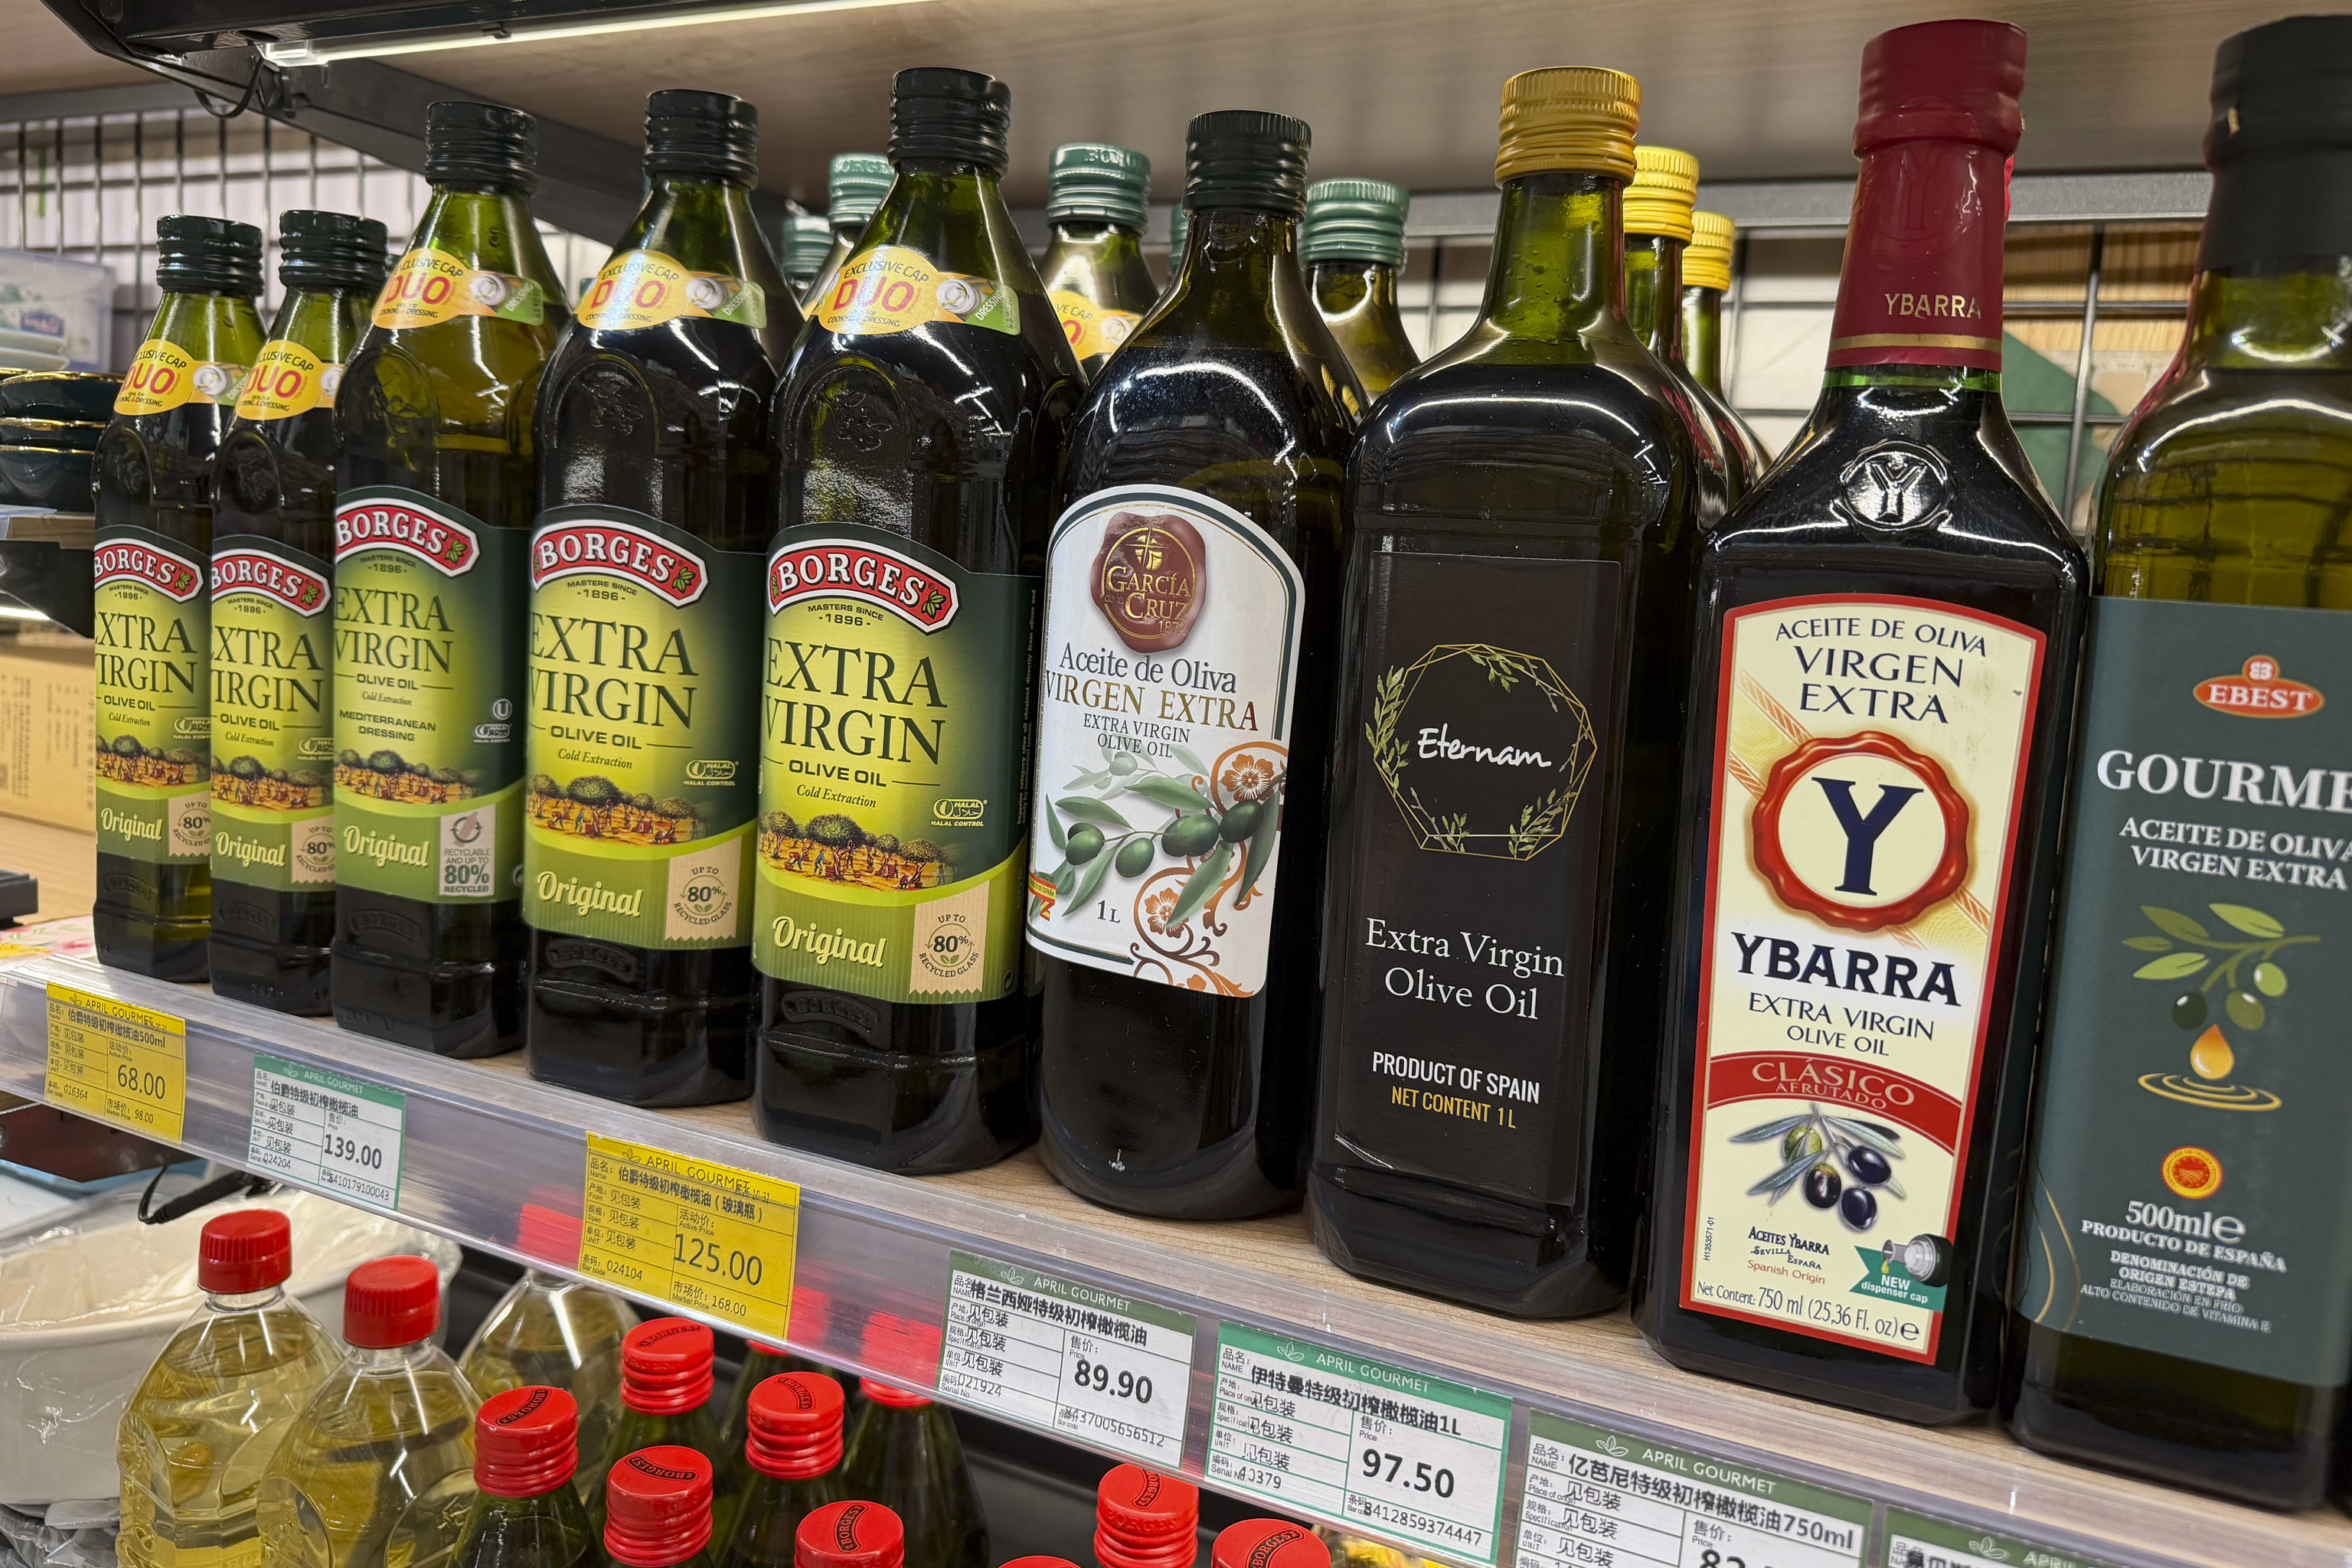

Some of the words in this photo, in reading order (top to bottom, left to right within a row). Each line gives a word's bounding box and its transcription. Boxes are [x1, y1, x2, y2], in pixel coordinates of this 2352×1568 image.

[903, 266, 929, 283] CAP
[833, 276, 915, 312] DUO
[974, 289, 1005, 322] DRESSING
[1884, 293, 1981, 319] YBARRA
[337, 511, 448, 554] BORGES
[94, 548, 177, 584] BORGES
[539, 533, 675, 583] BORGES
[211, 560, 304, 598] BORGES
[777, 553, 926, 608] BORGES
[335, 586, 454, 632] EXTRA
[807, 603, 854, 612] MASTERS
[856, 606, 884, 622] SINCE
[1158, 620, 1187, 635] 1872
[335, 628, 454, 674] VIRGIN
[531, 612, 699, 676] EXTRA
[1775, 617, 1861, 642] ACEITE
[1870, 618, 1905, 640] DE
[1915, 624, 1987, 658] OLIVA
[767, 636, 948, 708] EXTRA
[1059, 642, 1129, 678] Aceite
[1135, 655, 1164, 684] de
[1171, 658, 1238, 694] Oliva
[1794, 645, 1964, 688] VIRGEN
[530, 665, 697, 729] VIRGIN
[1046, 669, 1145, 715] VIRGEN
[1158, 689, 1259, 732] EXTRA
[1799, 682, 1949, 724] EXTRA
[2206, 684, 2314, 712] EBEST
[339, 710, 436, 731] MEDITERRANEAN
[358, 726, 415, 741] DRESSING
[765, 694, 946, 766] VIRGIN
[1083, 713, 1129, 734] EXTRA
[1132, 720, 1191, 743] VIRGIN
[1097, 733, 1142, 754] OLIVE
[1148, 740, 1174, 759] OIL
[1417, 723, 1552, 768] Eternam
[789, 759, 849, 781] OLIVE
[854, 769, 887, 787] OIL
[796, 784, 820, 799] Cold
[822, 789, 877, 808] Extraction
[101, 807, 163, 841] Original
[1811, 776, 1925, 897] Y
[2118, 816, 2222, 848] ACEITE
[2226, 828, 2266, 853] DE
[216, 831, 287, 868] Original
[345, 825, 430, 867] Original
[444, 848, 491, 856] RECYCLABLE
[444, 864, 490, 885] 80%
[2131, 844, 2242, 879] VIRGEN
[2245, 858, 2349, 891] EXTRA
[537, 871, 643, 916] Original
[938, 914, 951, 923] UP
[953, 913, 966, 923] TO
[773, 915, 887, 968] Original
[933, 935, 969, 952] 80%
[1365, 917, 1451, 958] Extra
[1460, 931, 1565, 979] Virgin
[920, 952, 956, 978] RECYCLED
[957, 952, 978, 975] GLASS
[1730, 932, 1962, 1008] YBARRA
[86, 998, 108, 1014] APRIL
[113, 1006, 153, 1025] GOURMET
[1385, 966, 1473, 1008] Olive
[1485, 983, 1538, 1020] Oil
[1749, 991, 1832, 1024] EXTRA
[1843, 1007, 1935, 1041] VIRGIN
[1786, 1025, 1847, 1049] OLIVE
[1854, 1036, 1890, 1057] OIL
[64, 1084, 88, 1101] 016364
[117, 1064, 165, 1100] 68.00
[304, 1071, 325, 1084] APRIL
[327, 1076, 363, 1094] GOURMET
[1372, 1051, 1456, 1086] PRODUCT
[1459, 1067, 1483, 1091] OF
[1486, 1073, 1540, 1105] SPAIN
[1752, 1058, 1916, 1107] CLÁSICO
[1775, 1082, 1887, 1110] AFRUTADO
[135, 1109, 154, 1124] 98.00
[1391, 1086, 1419, 1108] NET
[1422, 1092, 1491, 1122] CONTENT
[263, 1152, 291, 1170] 024204
[324, 1133, 382, 1170] 139.00
[646, 1155, 680, 1175] APRIL
[687, 1166, 750, 1192] GOURMET
[674, 1233, 763, 1286] 125.00
[2080, 1219, 2182, 1252] PRODUCTO
[2184, 1240, 2211, 1258] DE
[2213, 1244, 2288, 1273] ESPAÑA
[606, 1260, 643, 1282] 024104
[1747, 1259, 1788, 1277] Spanish
[1792, 1269, 1825, 1285] Origin
[1881, 1274, 1911, 1290] NEW
[2110, 1250, 2225, 1284] DENOMINACIÓN
[2226, 1272, 2250, 1290] DE
[2118, 1266, 2177, 1288] ORIGEN
[2177, 1277, 2236, 1302] ESTEPA
[712, 1295, 747, 1317] 168.00
[1034, 1276, 1067, 1295] APRIL
[1071, 1286, 1131, 1312] GOURMET
[1697, 1280, 1714, 1297] Net
[1716, 1284, 1756, 1306] Content:
[1759, 1286, 1783, 1311] 750
[1786, 1295, 1803, 1316] ml
[1808, 1299, 1851, 1327] (25,36
[1855, 1308, 1870, 1331] Fl.
[1874, 1316, 1899, 1339] oz)
[1860, 1281, 1908, 1299] dispenser
[1909, 1290, 1929, 1305] cap
[2079, 1283, 2111, 1300] ALTO
[2112, 1290, 2181, 1315] CONTENIDO
[2182, 1305, 2199, 1318] DE
[2201, 1308, 2258, 1331] VITAMINA
[2110, 1278, 2193, 1303] ELABORACIÓN
[2194, 1295, 2211, 1308] EN
[958, 1374, 1002, 1397] 021924
[1074, 1359, 1153, 1404] 89.90
[1316, 1353, 1355, 1374] APRIL
[1360, 1364, 1430, 1393] GOURMET
[1362, 1448, 1455, 1498] 97.50
[1642, 1448, 1687, 1471] APRIL
[1693, 1461, 1776, 1494] GOURMET
[1568, 1453, 1854, 1550] 亿芭尼特级初榨橄榄油750ml
[839, 1509, 859, 1545] BORGES
[1364, 1501, 1482, 1547] 8412859374447
